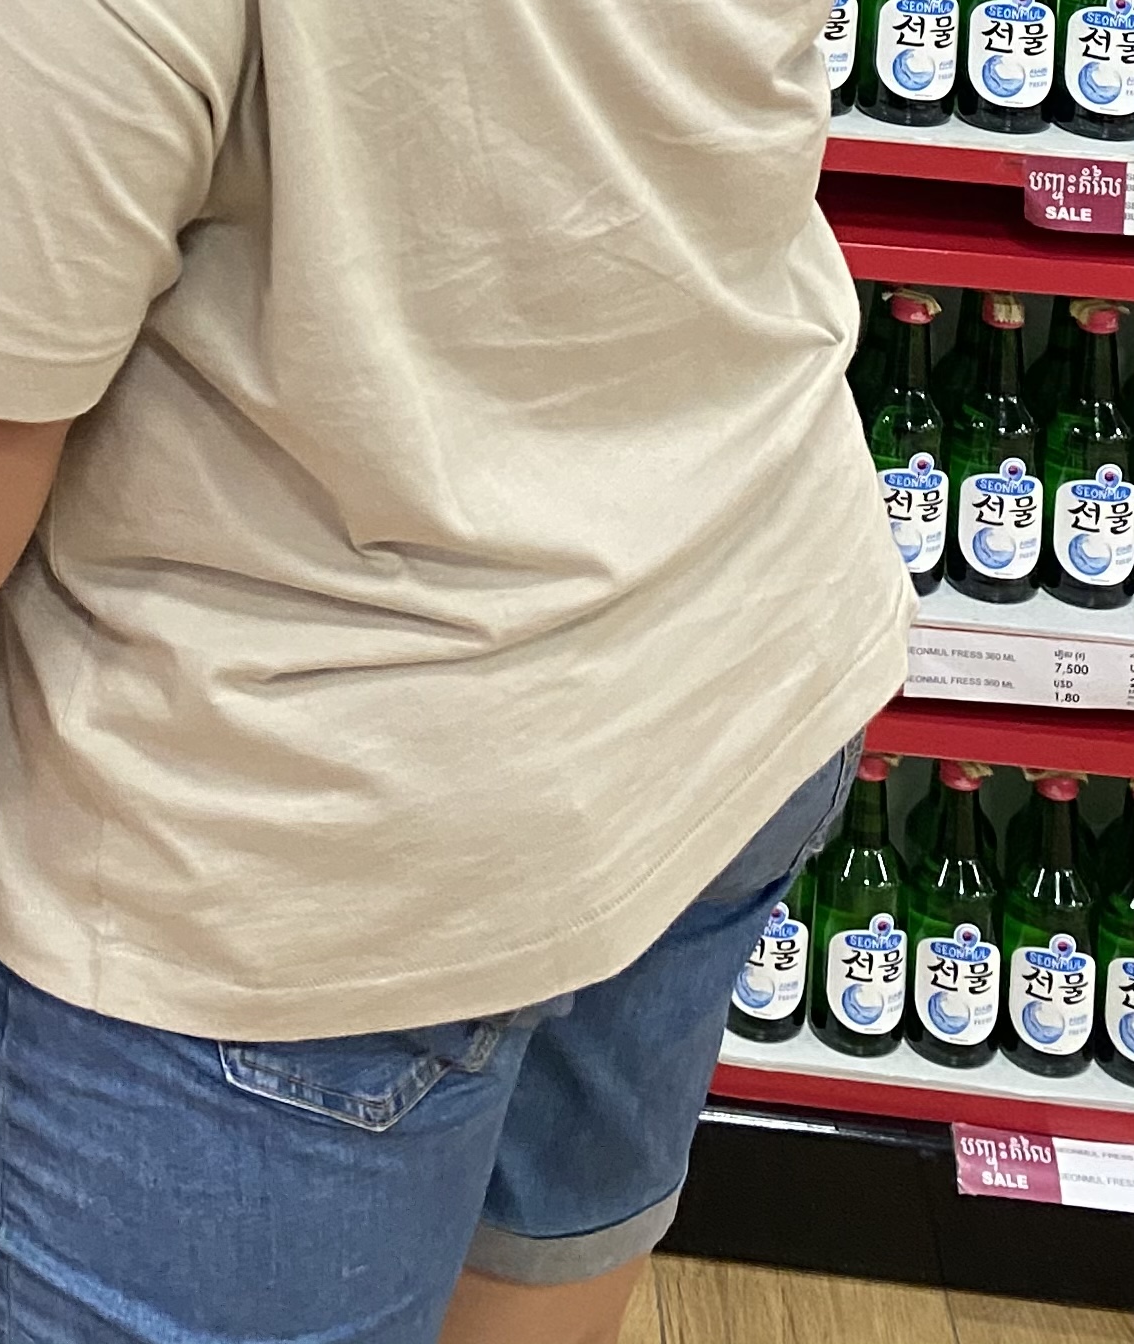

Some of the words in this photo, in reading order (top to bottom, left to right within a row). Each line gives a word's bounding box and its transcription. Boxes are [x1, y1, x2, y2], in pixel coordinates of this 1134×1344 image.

[902, 0, 952, 13] SEONMUL
[987, 4, 1043, 21] SEONMUL
[892, 14, 955, 49] 선물
[981, 20, 1048, 56] 선물
[1045, 206, 1092, 222] SALE
[887, 473, 941, 490] SEONMUL
[979, 479, 1032, 495] SEONMUL
[1075, 485, 1129, 501] SEONMUL
[884, 488, 944, 522] 선물
[972, 494, 1037, 529] 선물
[1068, 500, 1133, 535] 선물
[951, 649, 983, 660] FRESS
[985, 652, 1002, 661] 360
[1003, 653, 1016, 662] ML
[1054, 663, 1089, 676] 7,500
[950, 677, 982, 686] FRESS
[983, 678, 1000, 688] 360
[1002, 680, 1015, 689] ML
[1053, 679, 1074, 690] USD
[933, 941, 988, 960] SEONMUL
[841, 949, 904, 983] 선물
[1028, 951, 1083, 970] SEONMUL
[927, 957, 993, 995] 선물
[1022, 966, 1089, 1005] 선물
[981, 1171, 1029, 1189] SALE
